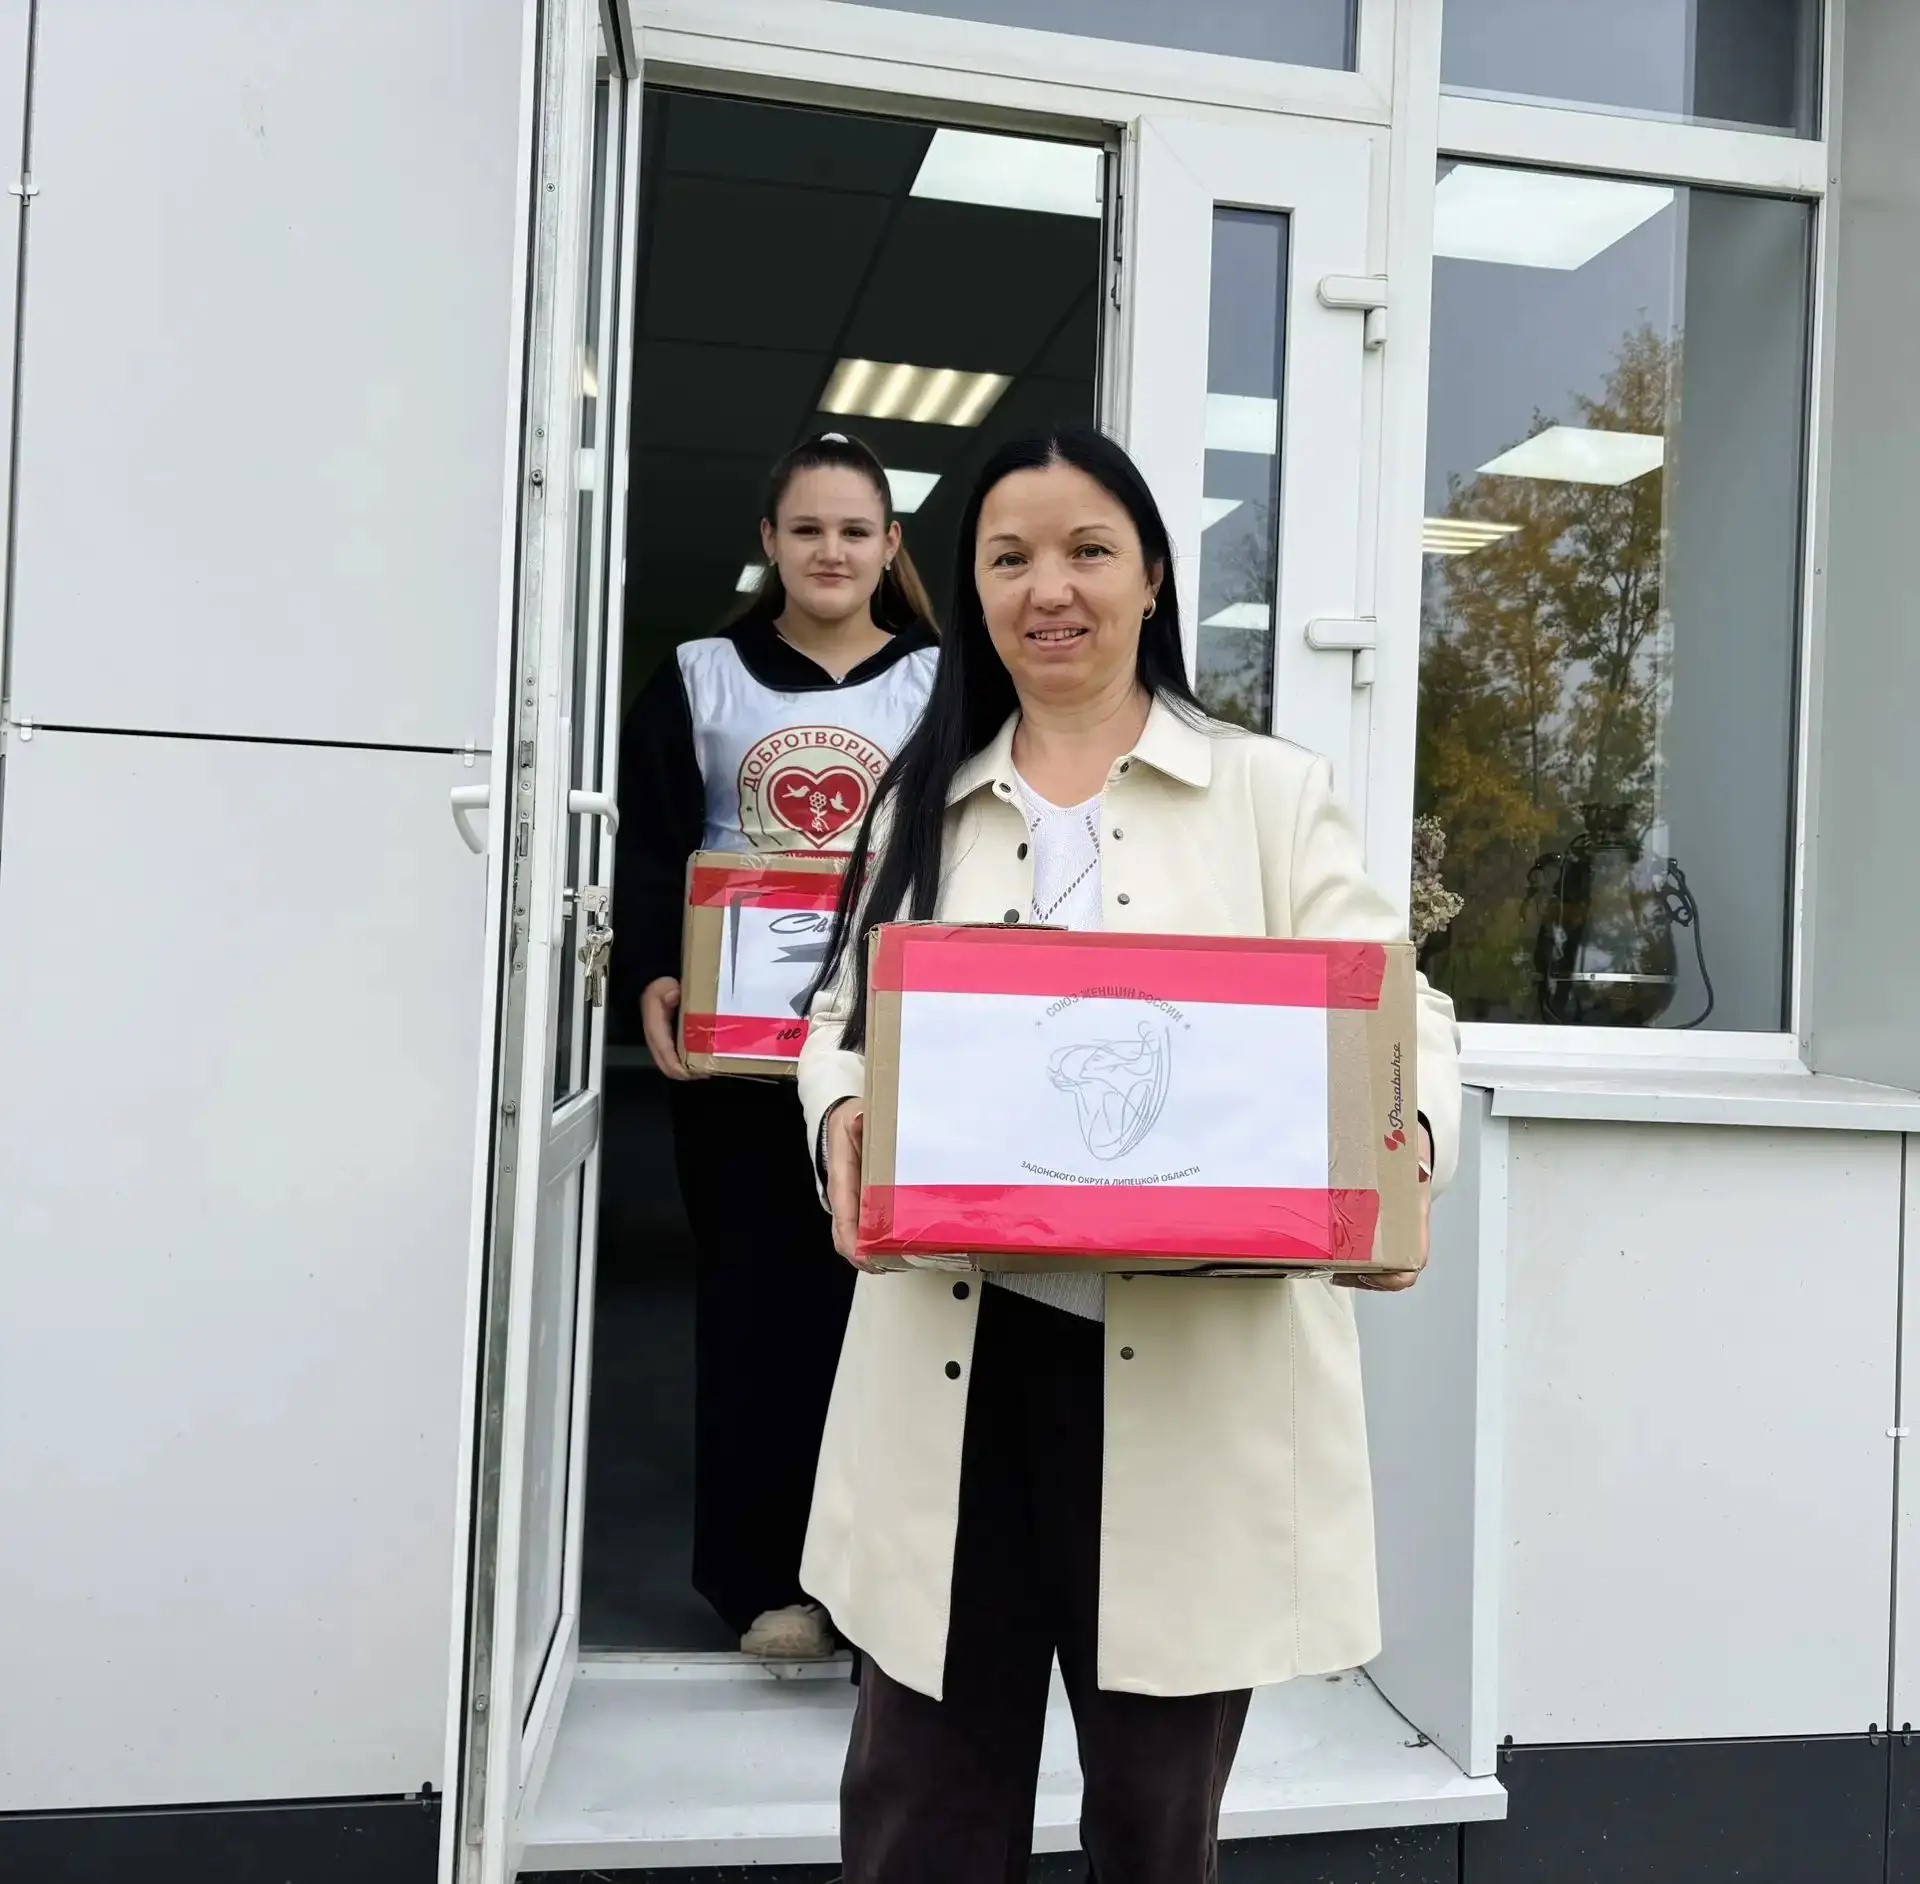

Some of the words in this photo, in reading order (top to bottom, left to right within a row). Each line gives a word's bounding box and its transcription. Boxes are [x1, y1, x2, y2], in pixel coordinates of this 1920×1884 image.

[768, 912, 829, 934] Св
[1046, 993, 1079, 1018] СОЮЗ
[1080, 985, 1137, 1001] ЖЕНЩИН
[1138, 991, 1184, 1022] РОССИИ
[1020, 1160, 1076, 1183] ЗАДОНСКОГО
[1078, 1175, 1110, 1186] ОКРУГА
[1111, 1174, 1160, 1187] ЛИПЕЦКОЙ
[1161, 1165, 1201, 1182] ОБЛАСТИ
